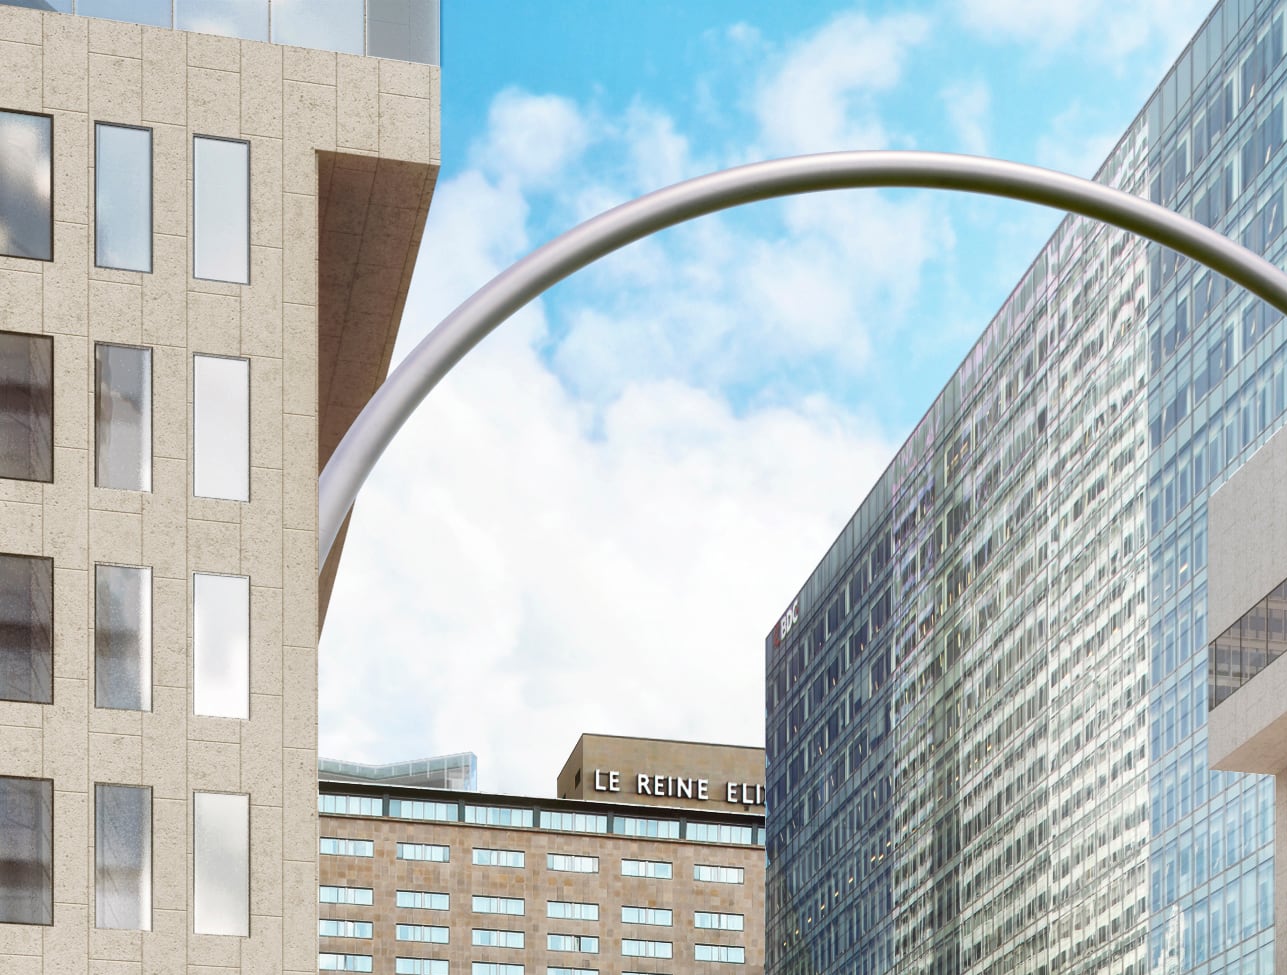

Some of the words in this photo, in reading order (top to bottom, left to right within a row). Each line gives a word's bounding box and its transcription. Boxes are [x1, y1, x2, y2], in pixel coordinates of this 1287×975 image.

[780, 599, 799, 641] BDC
[594, 768, 620, 792] LE
[637, 773, 709, 800] REINE
[727, 782, 767, 805] ELI
